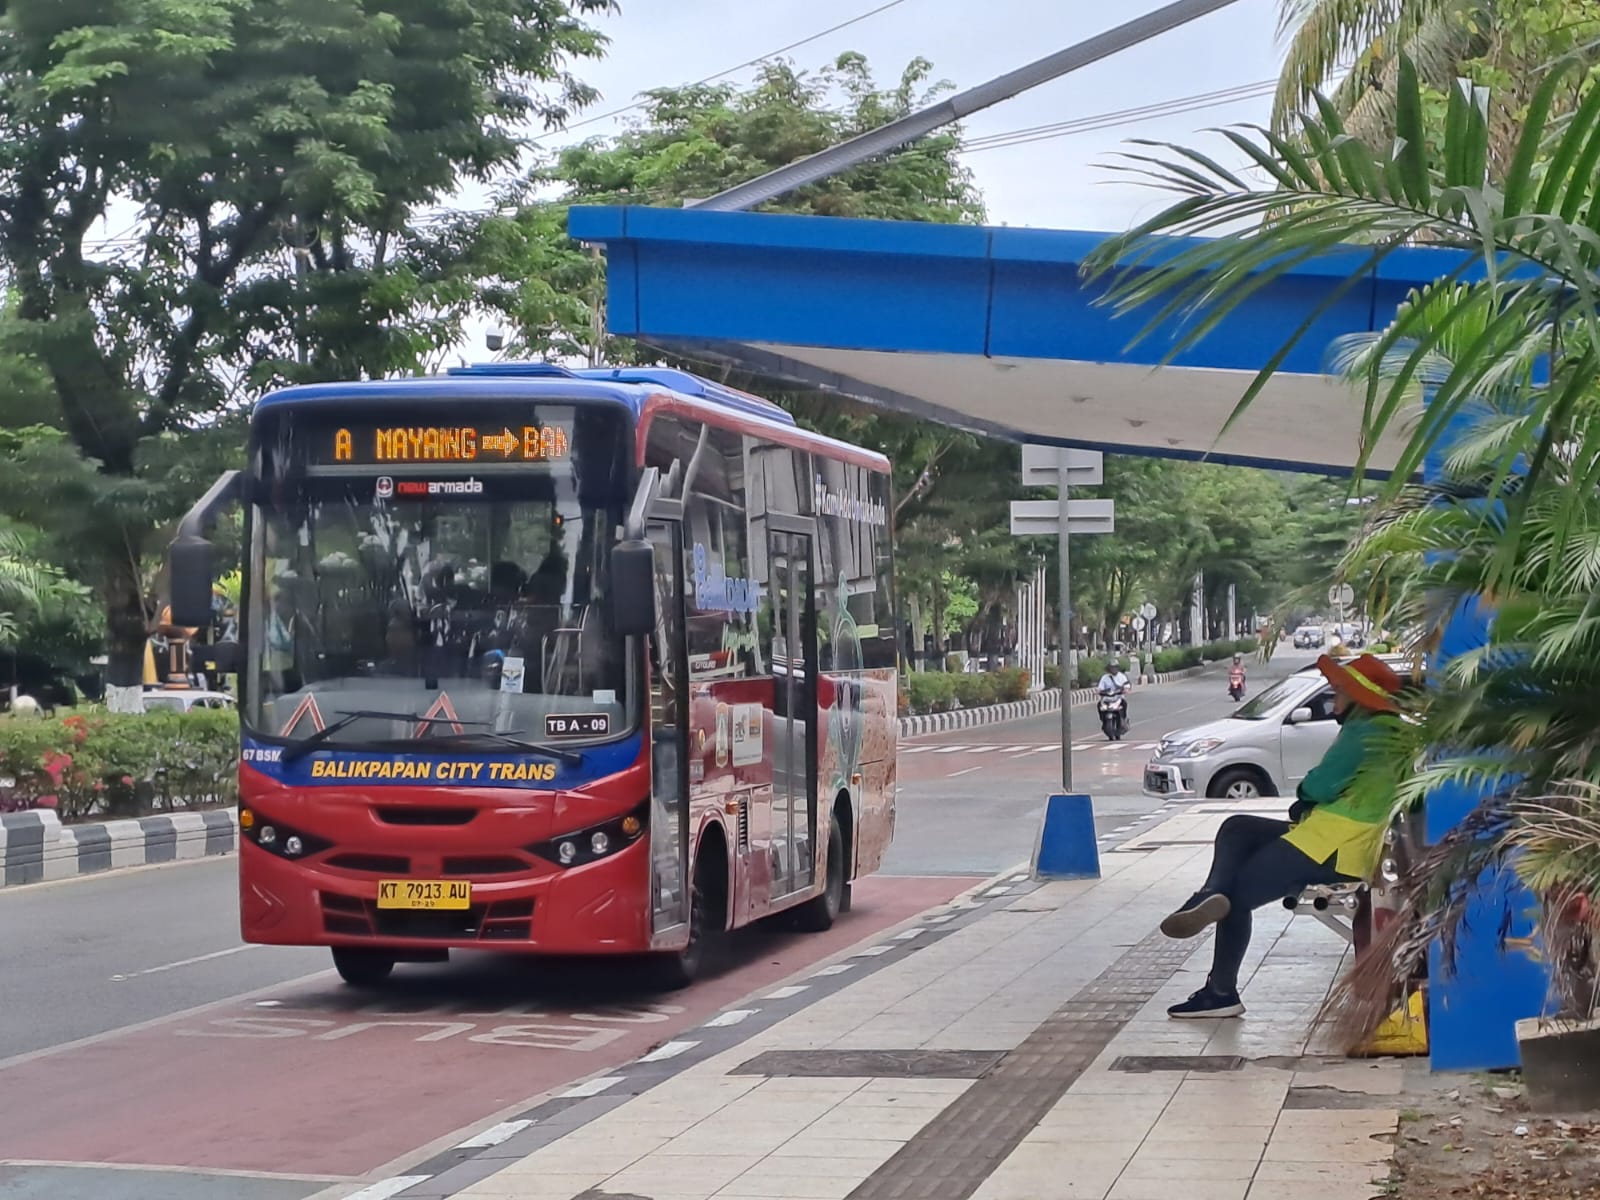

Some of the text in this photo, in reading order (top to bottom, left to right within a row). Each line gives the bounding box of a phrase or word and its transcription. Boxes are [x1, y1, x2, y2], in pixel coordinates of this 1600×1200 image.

[334, 428, 352, 460] A
[547, 719, 566, 732] TB
[569, 719, 580, 731] A
[591, 718, 607, 731] 09
[311, 760, 557, 781] BALIKPAPAN CITY TRANS
[380, 882, 467, 899] KT 7913 AU
[175, 1018, 629, 1051] BUS
